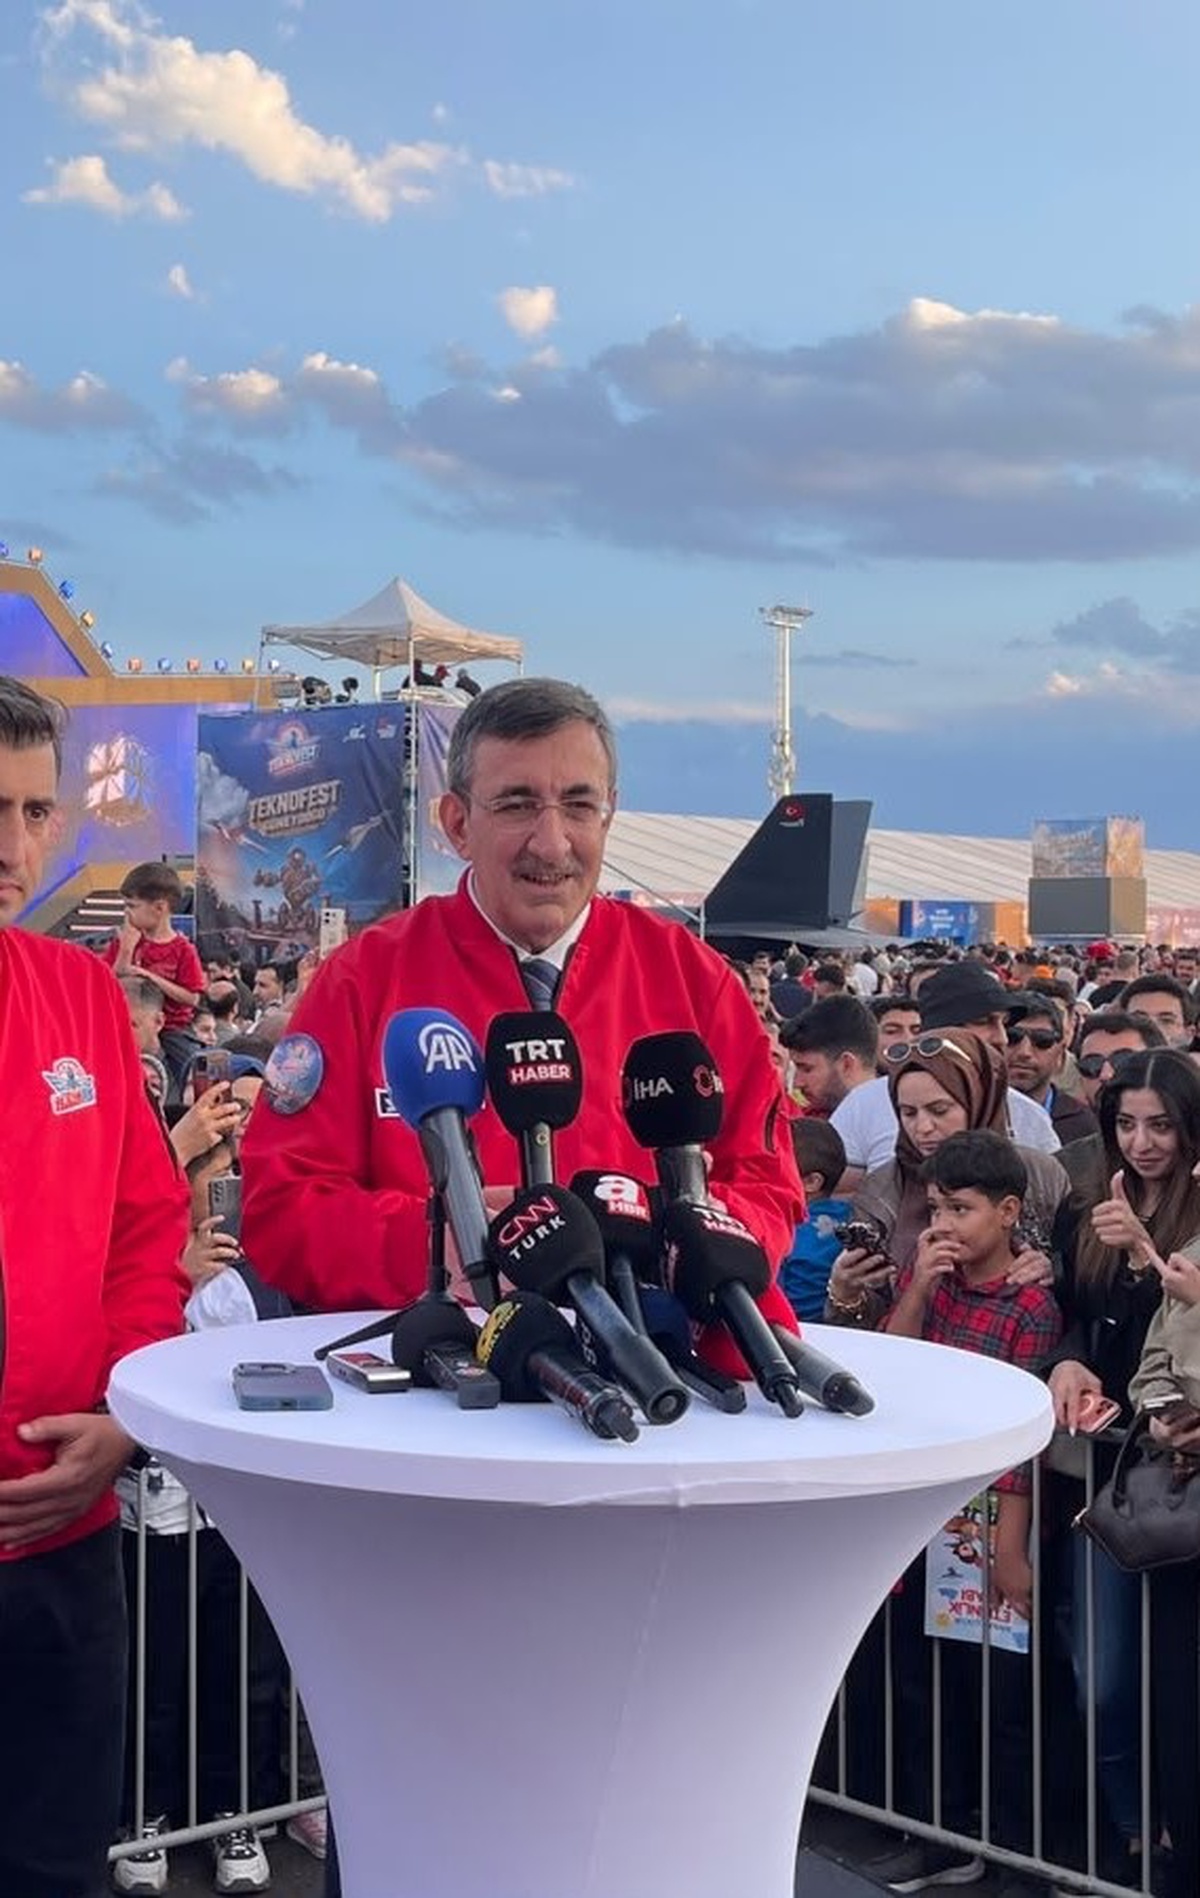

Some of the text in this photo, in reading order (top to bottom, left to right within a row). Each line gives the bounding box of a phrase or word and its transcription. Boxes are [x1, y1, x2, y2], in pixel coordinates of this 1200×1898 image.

[249, 779, 341, 821] TEKNOFEST
[426, 1034, 477, 1073] AA
[506, 1039, 565, 1063] TRT
[511, 1064, 571, 1084] HABER
[499, 1196, 557, 1244] CNN
